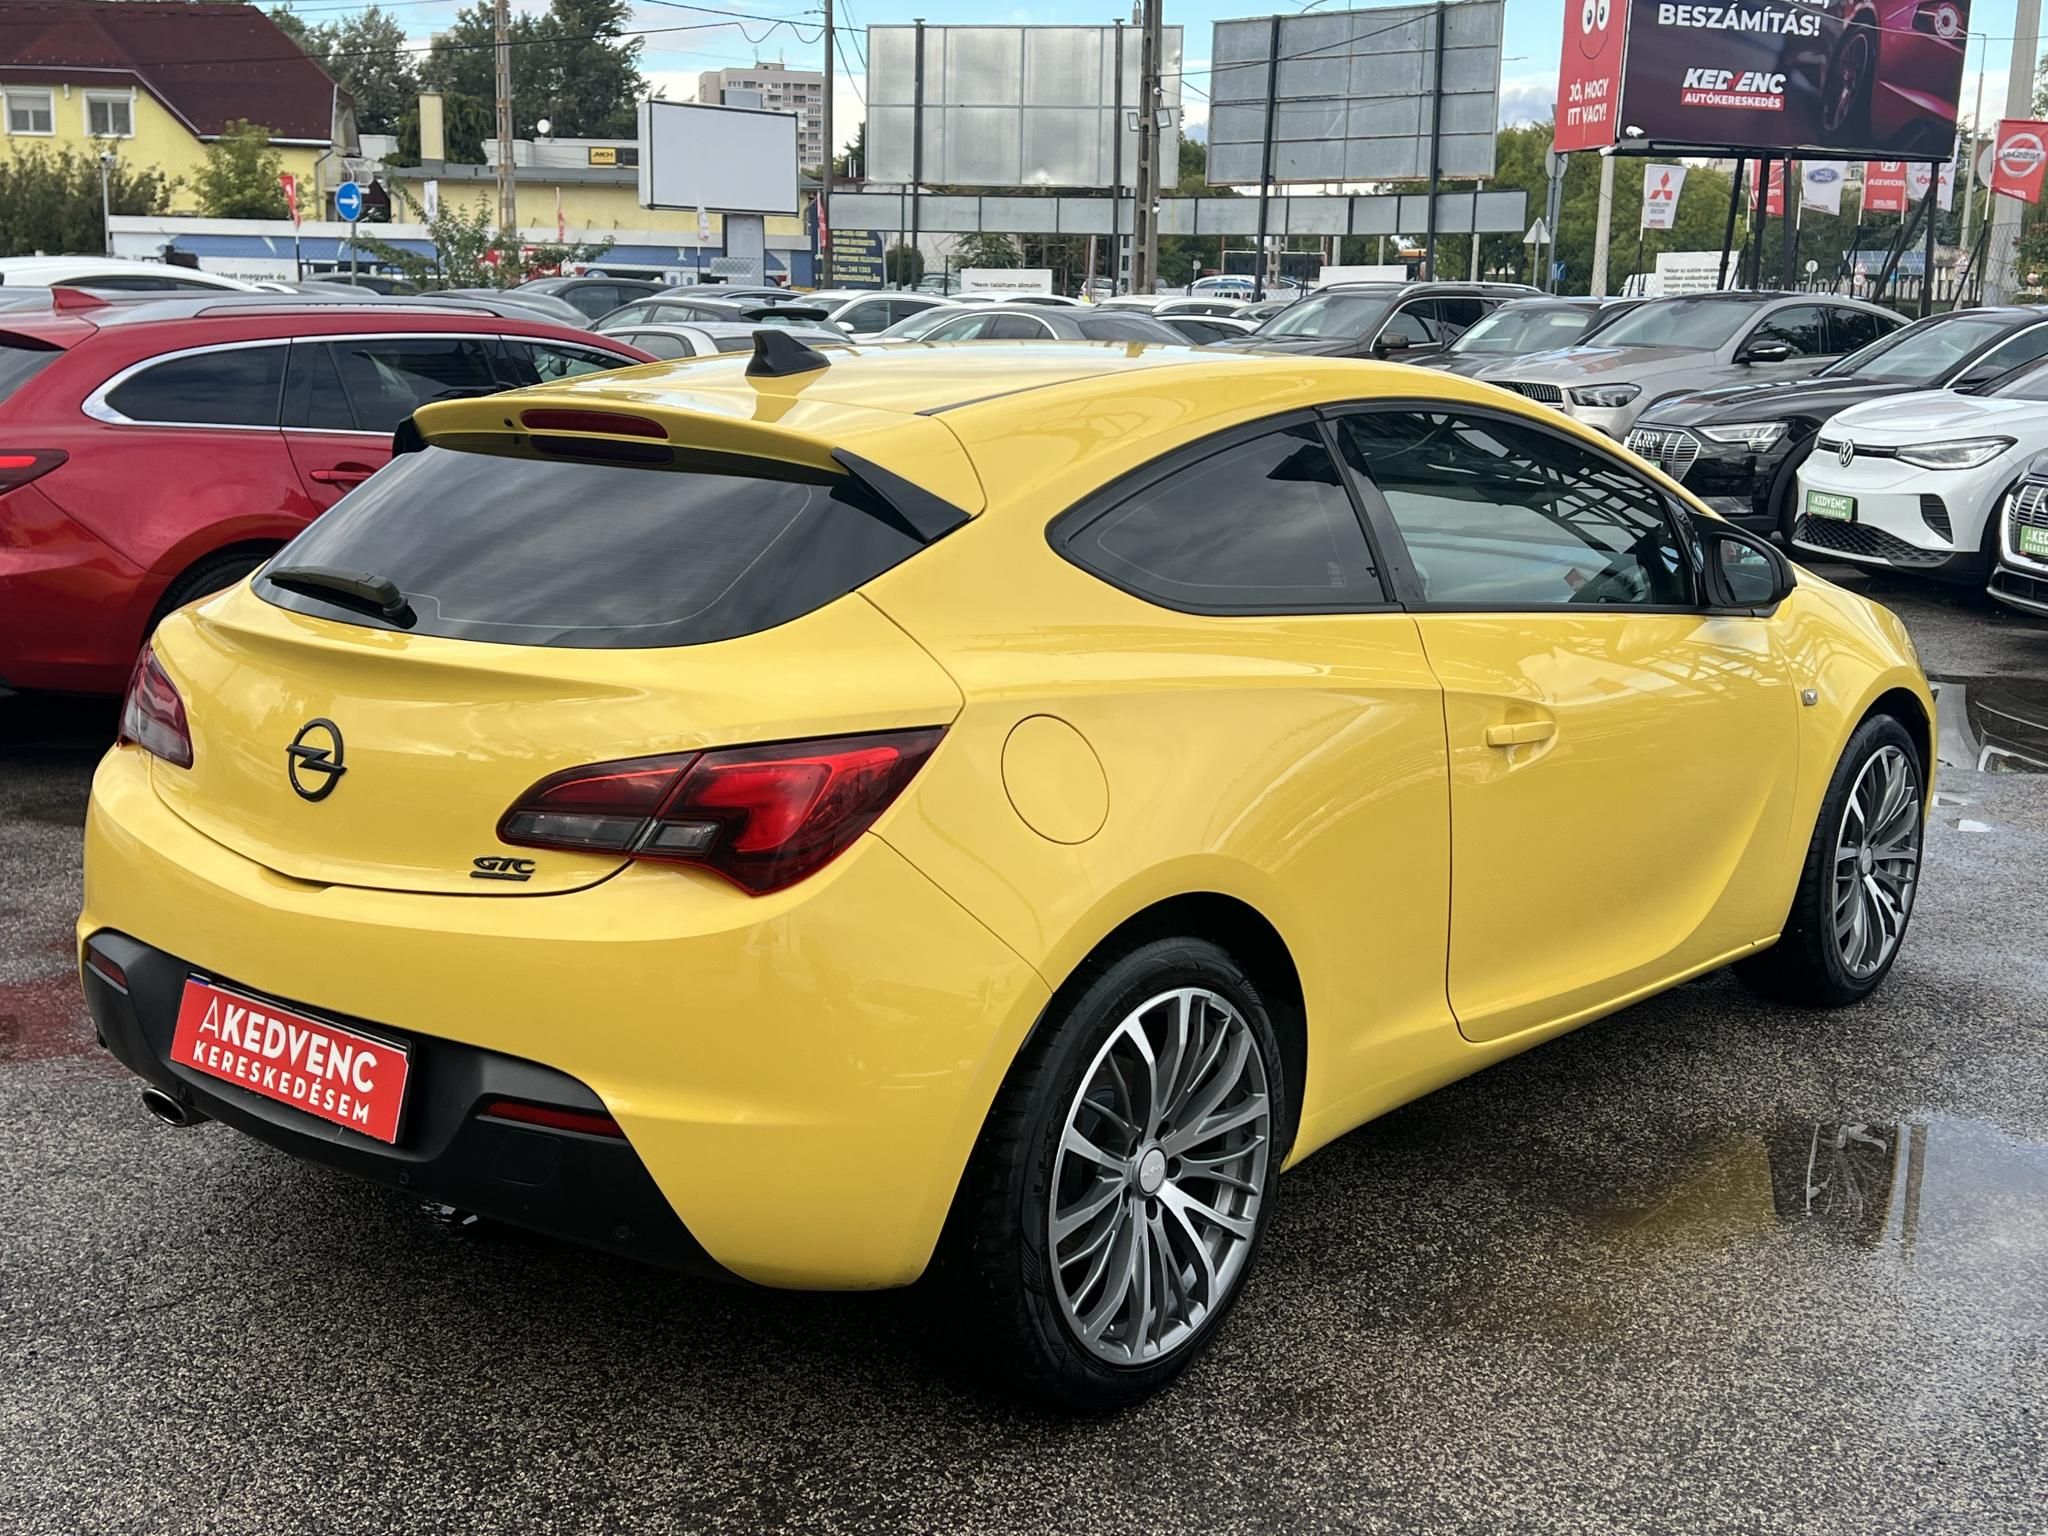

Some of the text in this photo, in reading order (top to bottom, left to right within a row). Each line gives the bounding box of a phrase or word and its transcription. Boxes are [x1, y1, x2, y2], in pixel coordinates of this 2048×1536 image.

[1658, 3, 1821, 37] BESZÁMÍTÁS!
[1569, 77, 1609, 104] JÓ, HOGY
[1684, 92, 1782, 108] AUTÓKERESKEDÉS
[1567, 102, 1608, 126] ITT VAGY!
[240, 272, 275, 281] megyek
[276, 272, 287, 280] és
[473, 857, 536, 874] GTC
[192, 1040, 370, 1125] KERESKEDÉSEM
